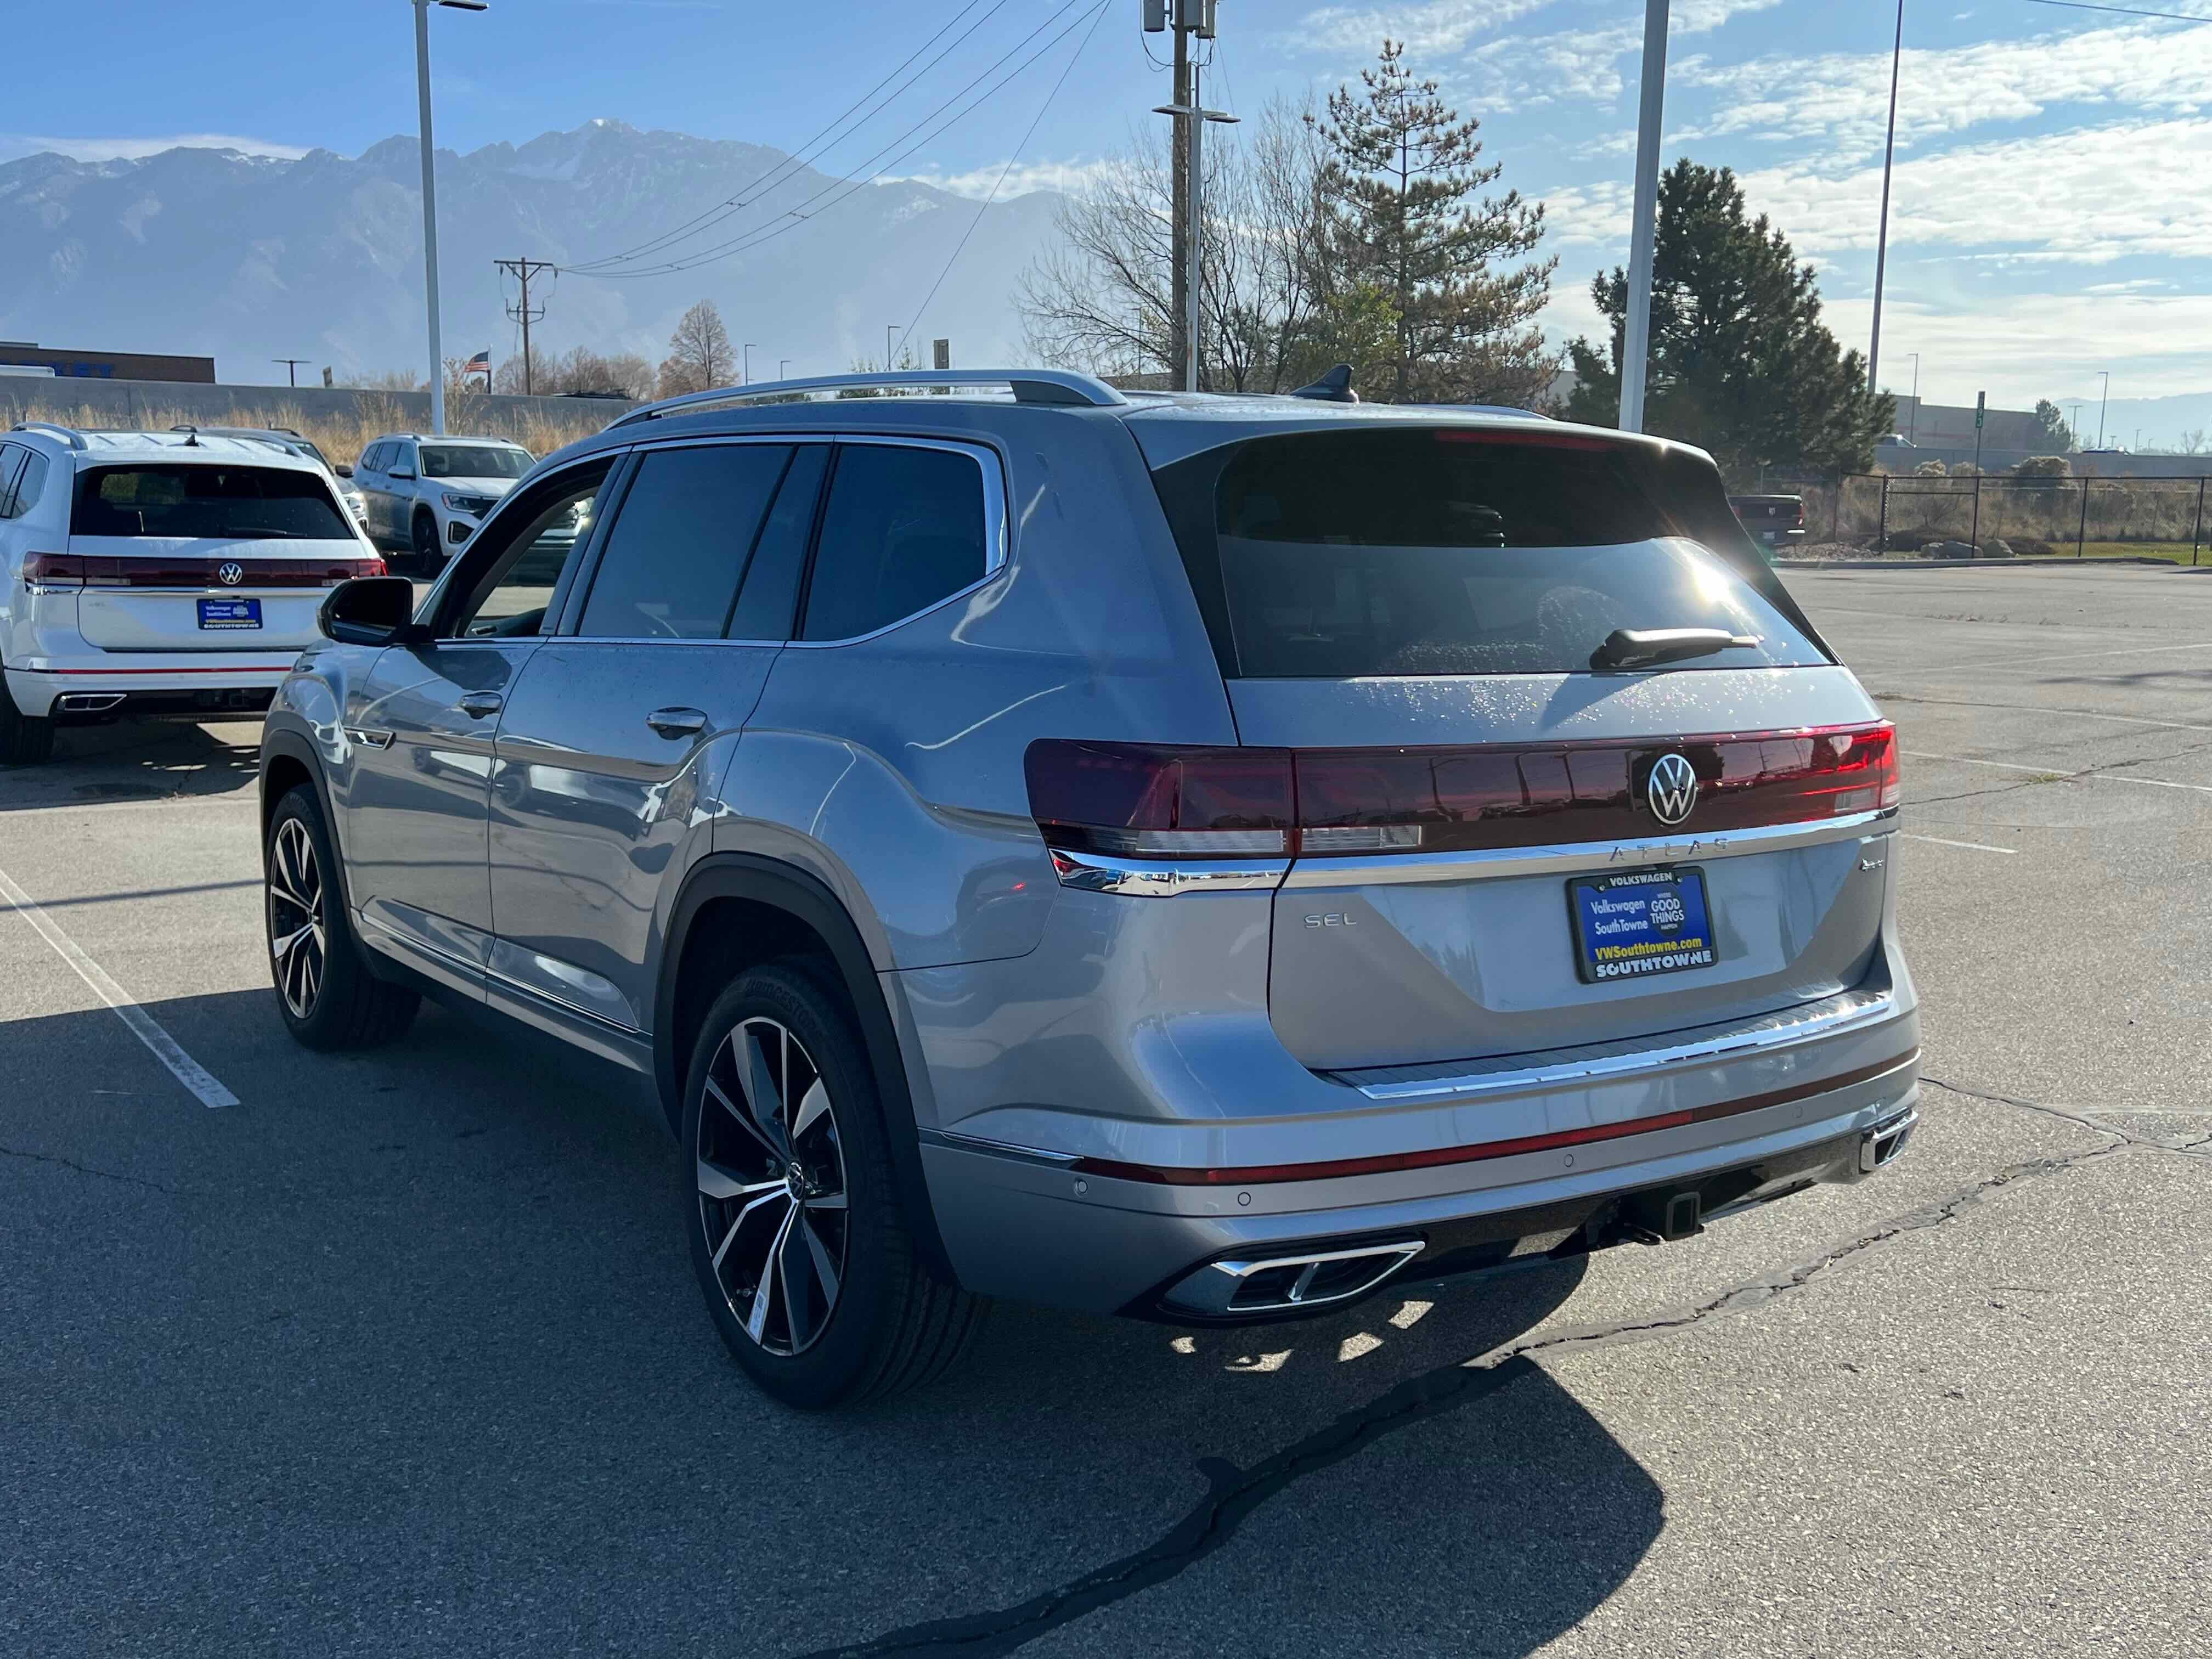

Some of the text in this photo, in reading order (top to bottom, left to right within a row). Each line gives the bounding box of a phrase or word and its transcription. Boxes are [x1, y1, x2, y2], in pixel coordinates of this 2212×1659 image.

[1648, 753, 1696, 825] VW
[1609, 838, 1728, 862] ATLAS
[1609, 872, 1673, 887] VOLKSWAGEN
[1590, 899, 1646, 915] Volkswagen
[1650, 898, 1680, 912] GOOD
[1304, 912, 1357, 928] SEL
[1650, 909, 1685, 924] THINGS
[1595, 917, 1649, 935] SouthTowne
[1595, 938, 1702, 961] VWSouthtowne.com
[1596, 950, 1712, 978] SOUTHTOWNE
